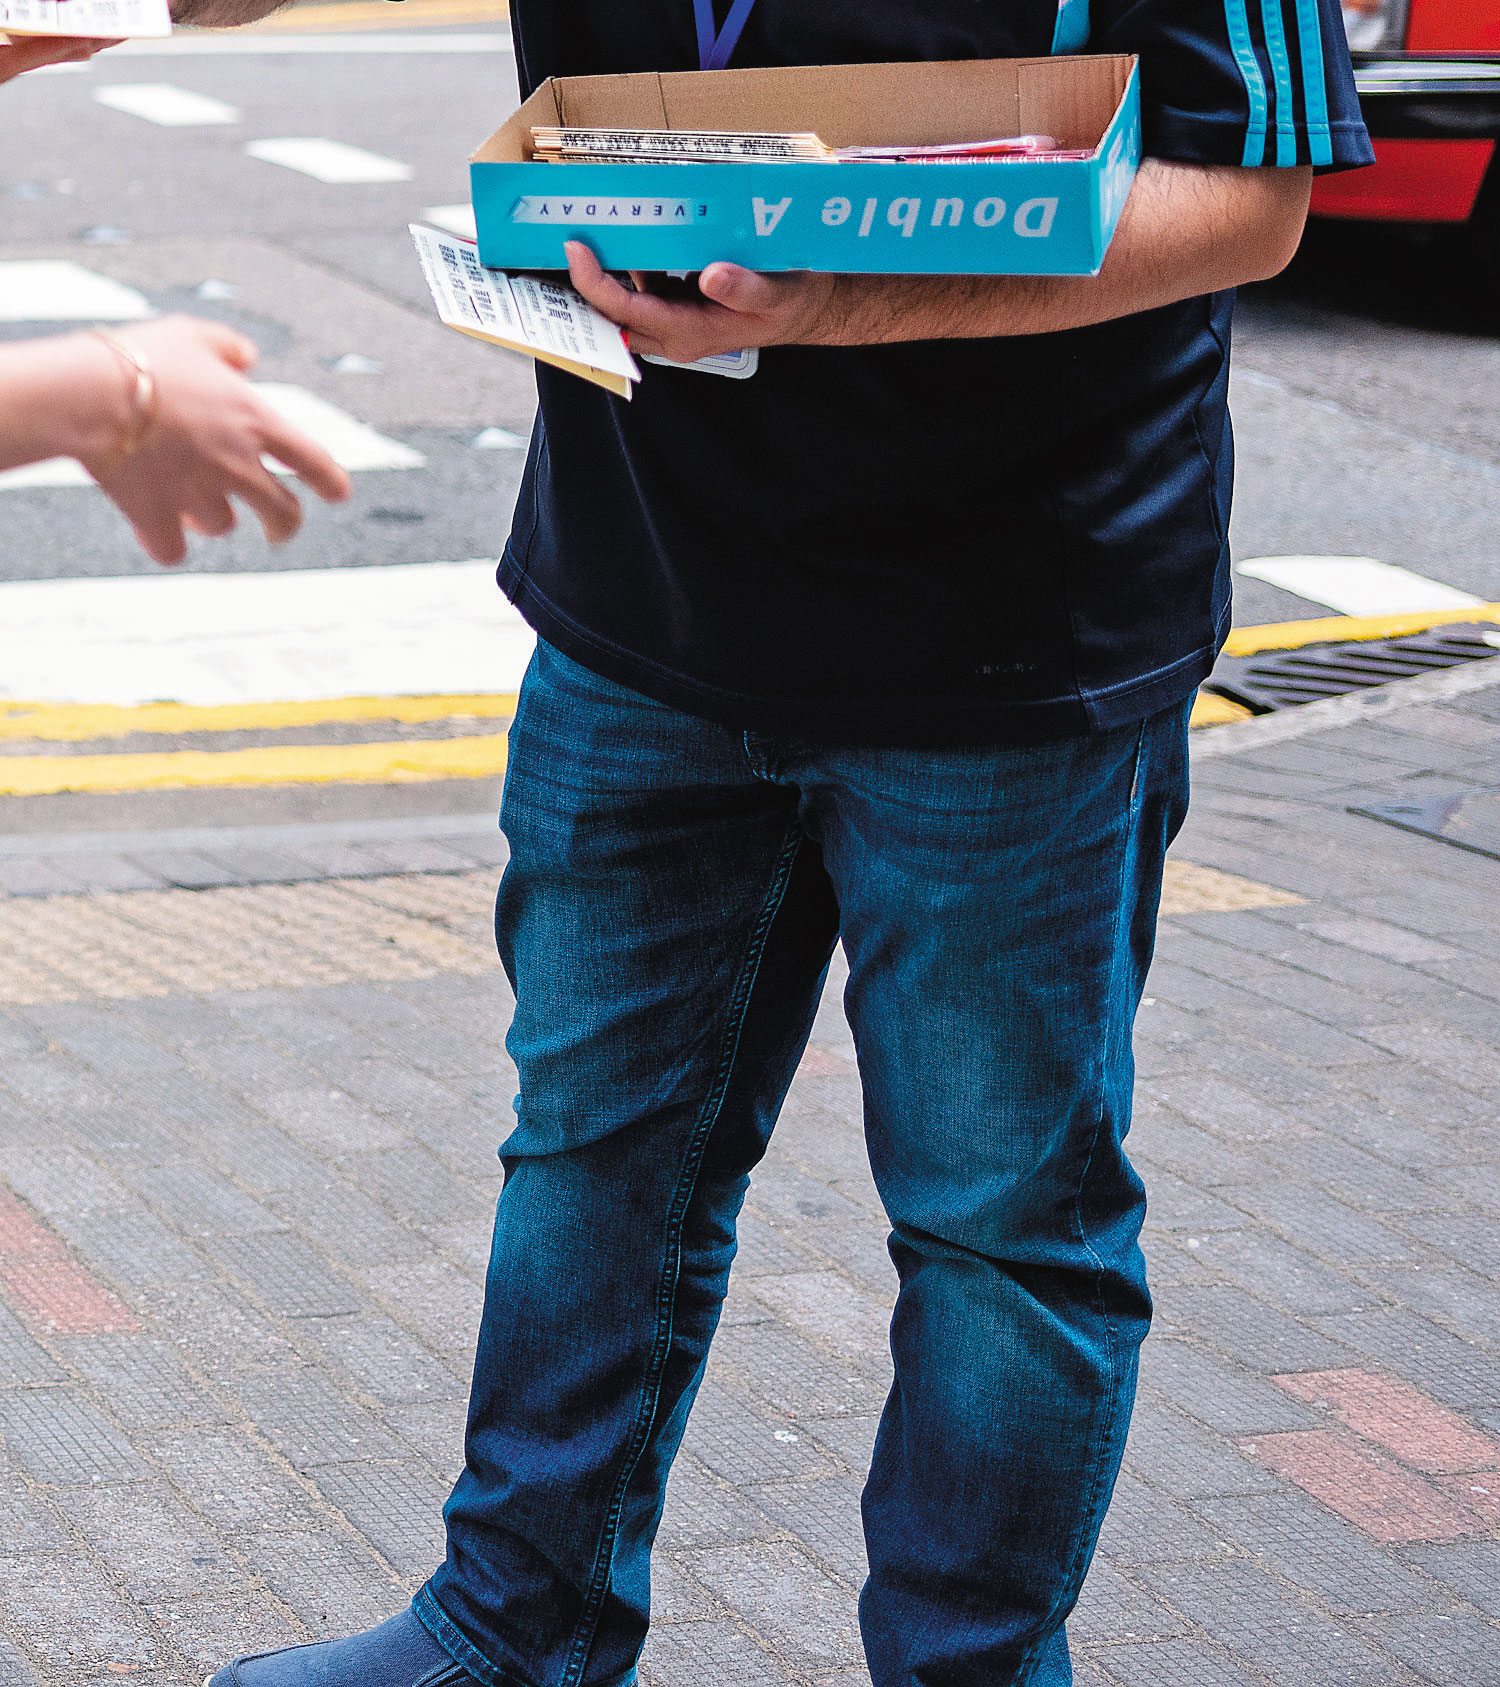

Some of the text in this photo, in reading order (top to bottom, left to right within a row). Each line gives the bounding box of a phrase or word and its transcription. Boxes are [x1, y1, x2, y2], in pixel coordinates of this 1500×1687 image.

[539, 203, 708, 217] EVERYDAY
[751, 196, 1059, 238] Double A
